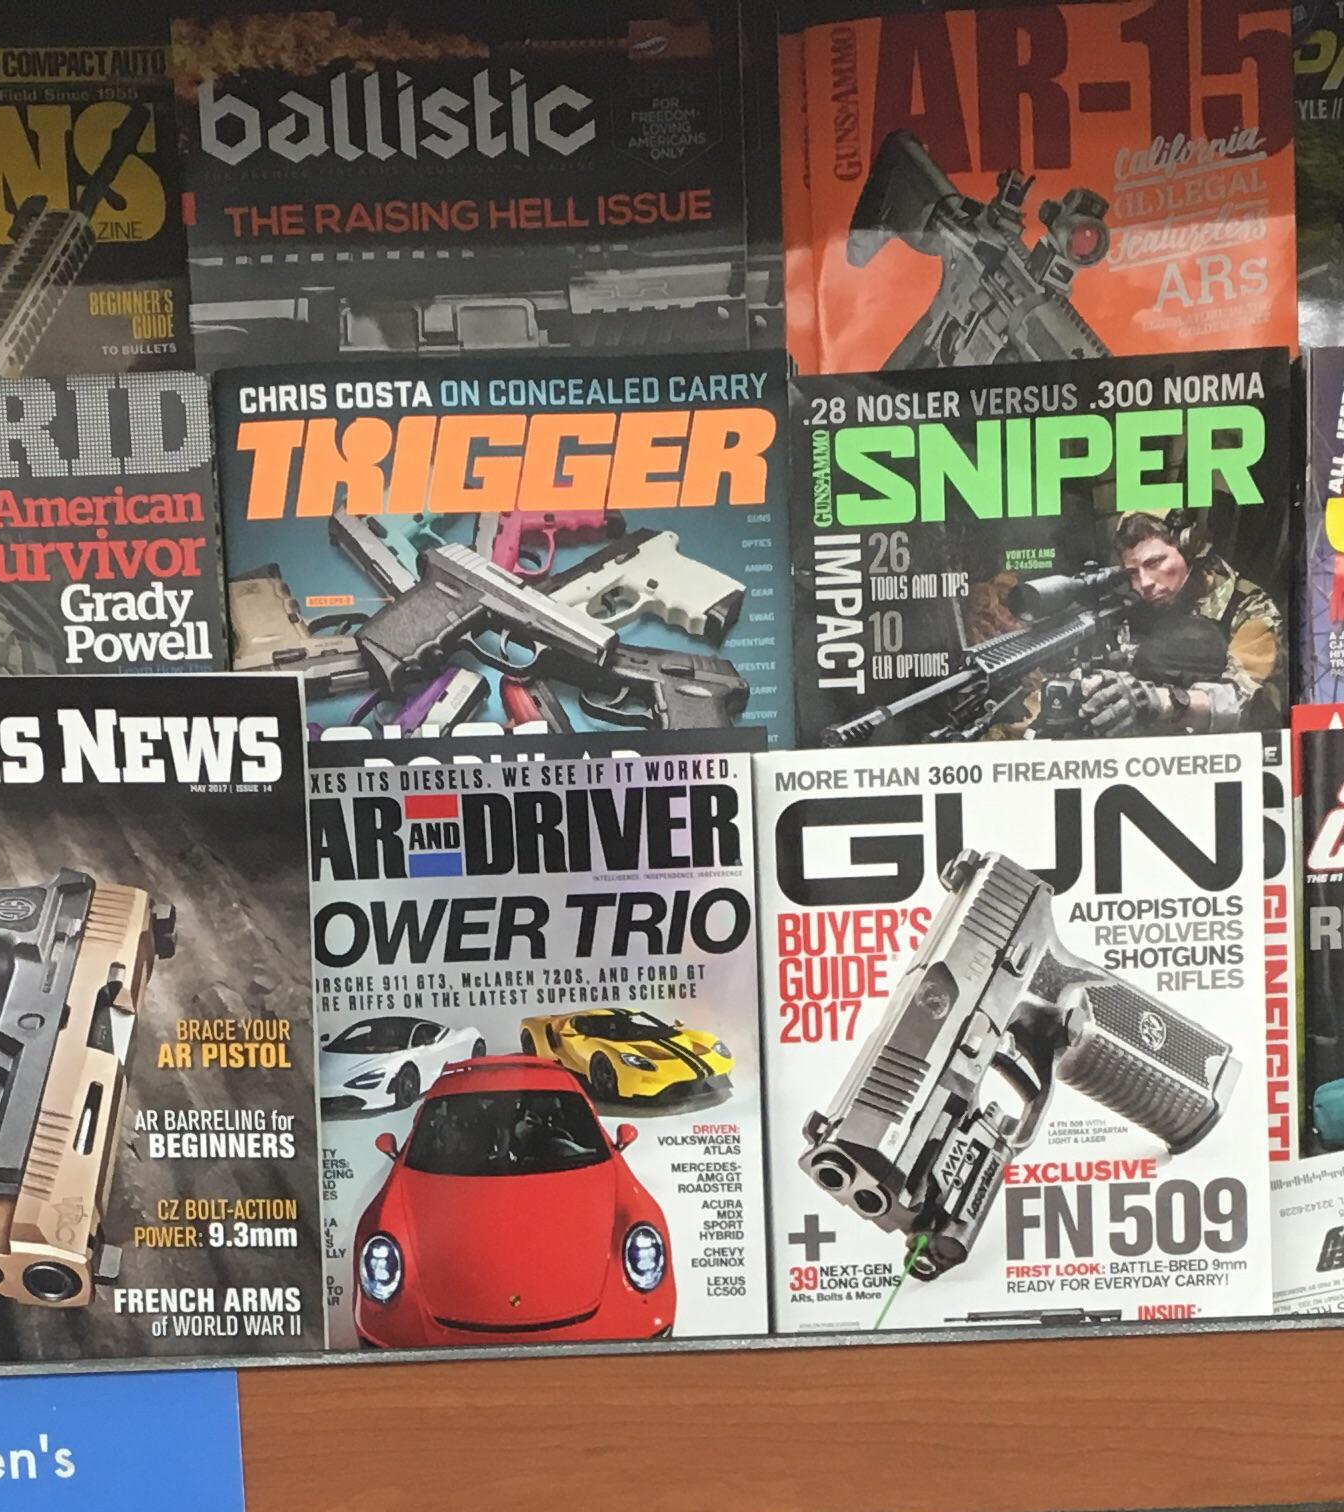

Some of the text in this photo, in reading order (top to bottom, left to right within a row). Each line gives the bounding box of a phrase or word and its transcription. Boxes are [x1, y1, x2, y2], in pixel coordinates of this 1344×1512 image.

[197, 68, 596, 166] ballistic
[225, 189, 712, 236] THE RAISING HELL ISSUE
[239, 372, 768, 414] CHRIS COSTA ON CONCEALED CARRY
[803, 372, 1265, 426] .28 NOSLER VERSUS .300 NORMA
[236, 409, 777, 520] TRIGGER
[834, 405, 1265, 527] SNIPER
[59, 584, 195, 632] Grady
[812, 534, 865, 694] IMPACT
[64, 622, 212, 665] Powell
[57, 710, 284, 784] NEWS
[775, 754, 1242, 791] MORE THAN 3600 FIREARMS COVERED
[1070, 897, 1243, 922] AUTOPISTOLS
[1095, 921, 1244, 946] REVOLVERS
[1104, 945, 1244, 969] SHOTGUNS
[1156, 969, 1244, 991] RIFLES
[148, 1134, 295, 1158] BEGINNERS
[1004, 1159, 1157, 1182] EXCLUSIVE
[1006, 1179, 1248, 1259] FN 509
